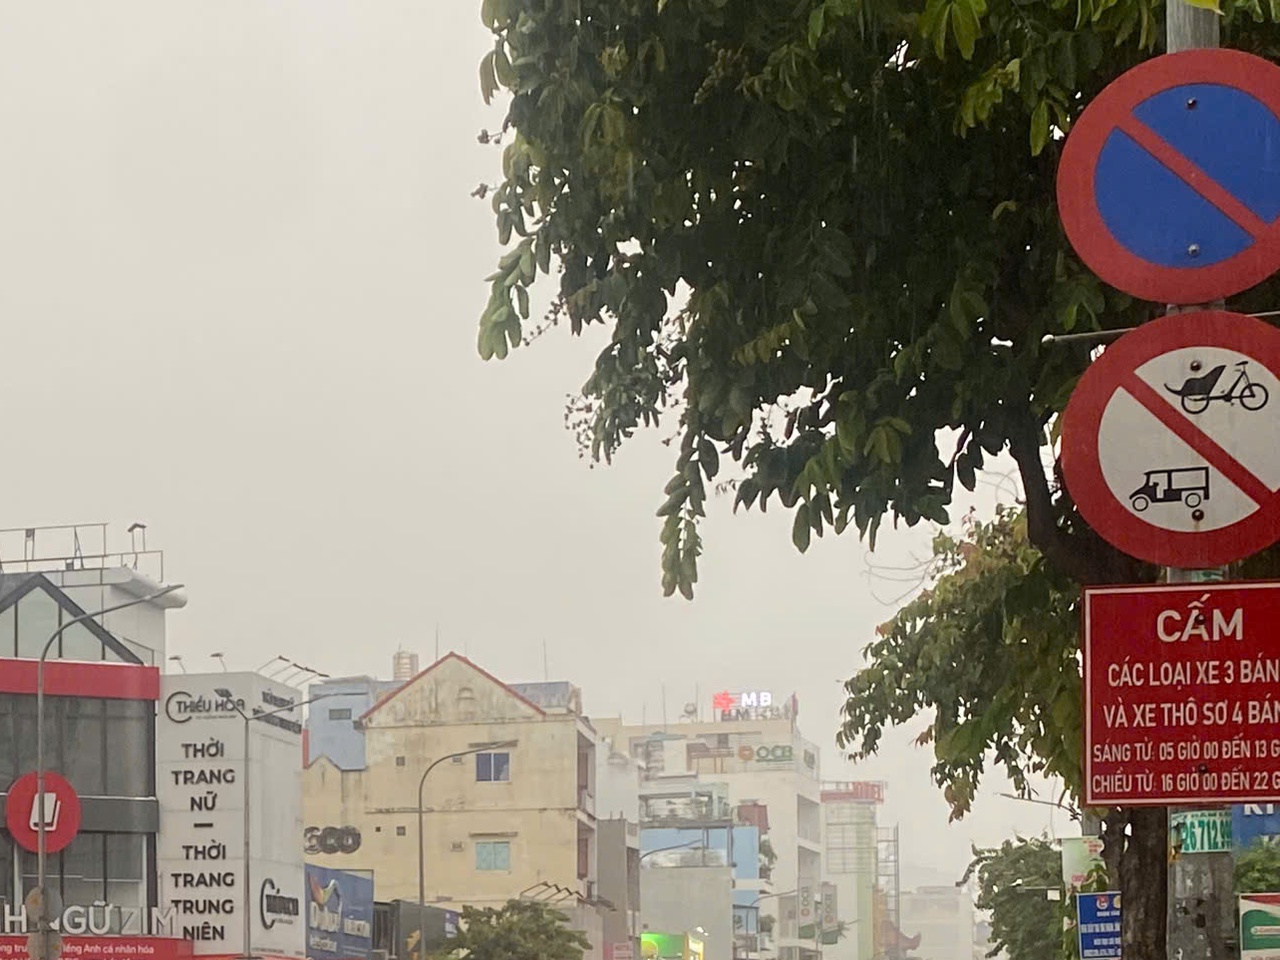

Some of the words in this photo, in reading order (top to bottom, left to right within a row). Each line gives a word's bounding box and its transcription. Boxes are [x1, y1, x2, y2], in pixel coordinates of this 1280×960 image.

[1156, 593, 1243, 642] CẤM
[1108, 655, 1145, 687] CÁC
[1149, 660, 1191, 691] LOẠI
[1196, 660, 1220, 685] XE
[1224, 660, 1235, 684] 3
[1103, 696, 1128, 729] VÀ
[1132, 703, 1157, 728] XE
[1160, 696, 1198, 727] THÔ
[1202, 700, 1229, 726] SƠ
[1232, 702, 1243, 725] 4
[181, 737, 224, 758] THỜI
[1093, 738, 1131, 763] SÁNG
[1159, 741, 1174, 761] 05
[1203, 740, 1219, 760] 00
[1222, 732, 1251, 760] ĐẾN
[1254, 740, 1267, 758] 13
[171, 769, 235, 785] TRANG
[1092, 766, 1133, 794] CHIỀU
[1161, 774, 1174, 792] 16
[1202, 771, 1218, 791] 00
[1221, 765, 1250, 791] ĐẾN
[1253, 772, 1269, 790] 22
[190, 791, 217, 811] NỮ
[182, 839, 226, 860] THỜI
[171, 872, 235, 888] TRANG
[171, 899, 234, 915] TRUNG
[121, 906, 176, 936] ZIM
[183, 921, 225, 941] NIÊN
[83, 946, 101, 954] Anh
